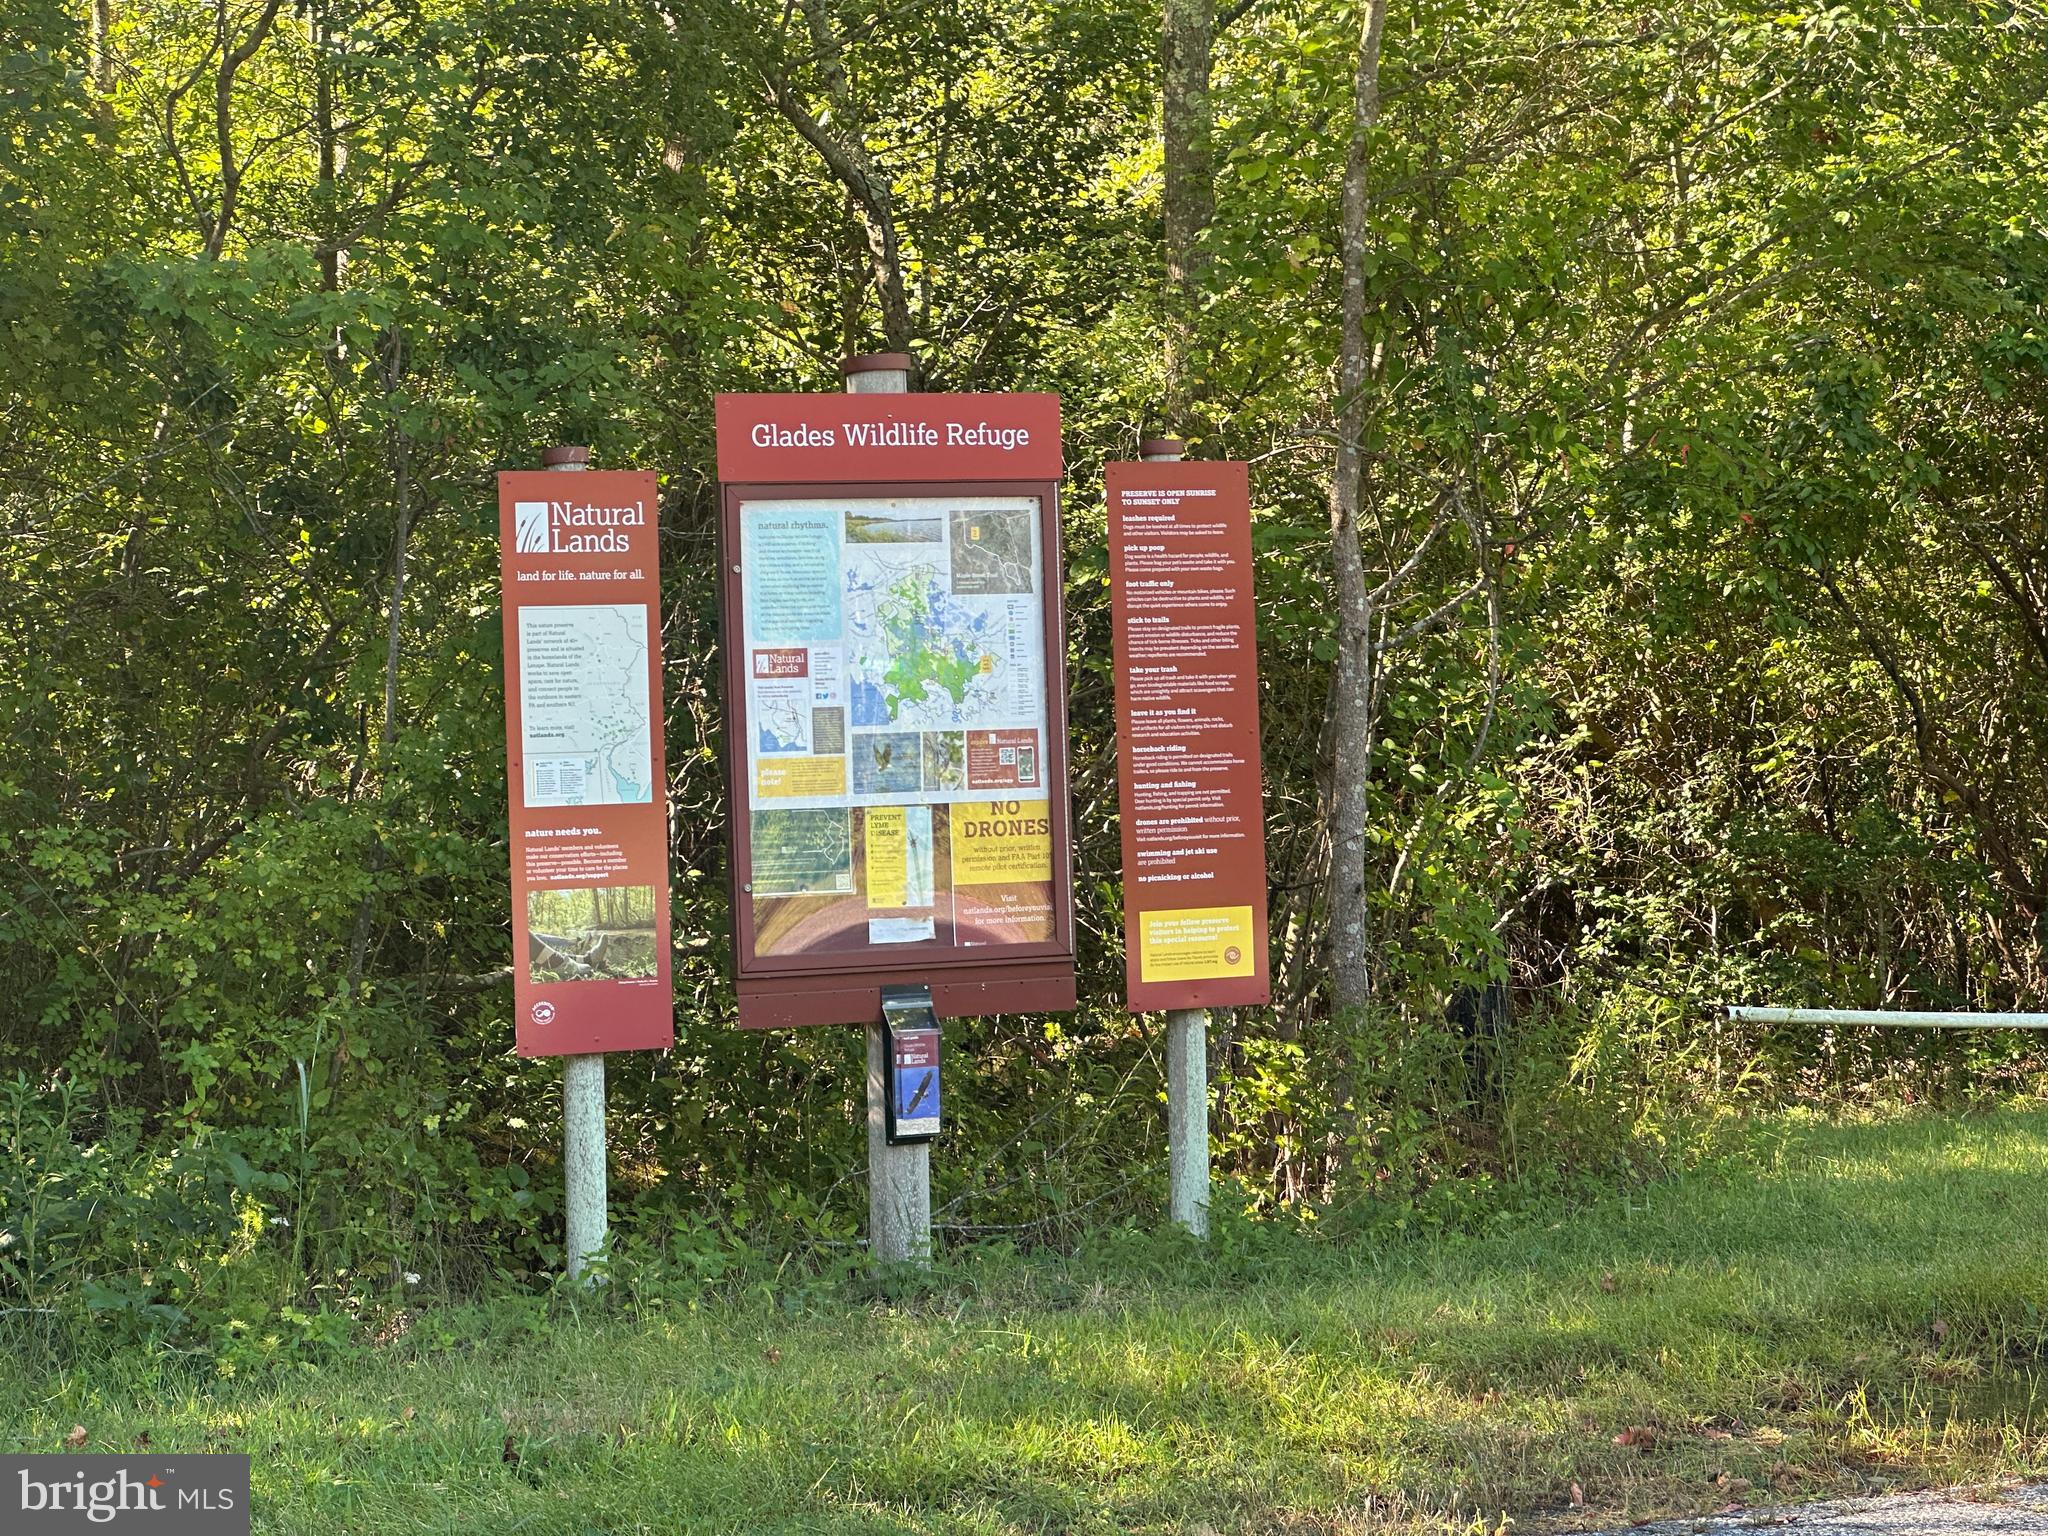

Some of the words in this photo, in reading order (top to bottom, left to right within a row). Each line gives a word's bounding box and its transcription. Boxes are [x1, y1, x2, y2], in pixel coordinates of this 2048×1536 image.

[751, 424, 834, 446] Glades
[843, 423, 937, 446] Wildlife
[947, 422, 1029, 450] Refuge
[551, 501, 645, 525] Natural
[758, 521, 788, 530] natural
[792, 520, 828, 531] rhythms.
[552, 528, 629, 552] Lands
[517, 571, 539, 581] land
[542, 571, 556, 580] for
[559, 570, 576, 580] life.
[580, 570, 611, 580] nature
[614, 570, 627, 579] for
[630, 570, 644, 579] all.
[770, 653, 804, 664] Natural
[770, 663, 798, 673] Lands
[1134, 782, 1159, 790] hunting
[991, 800, 1020, 815] NO
[1171, 817, 1203, 825] prohibited
[525, 828, 553, 837] nature
[556, 827, 580, 836] needs
[582, 828, 602, 836] you.
[964, 818, 1048, 838] DRONES
[1137, 850, 1171, 858] swimming
[1148, 874, 1181, 882] picnicking
